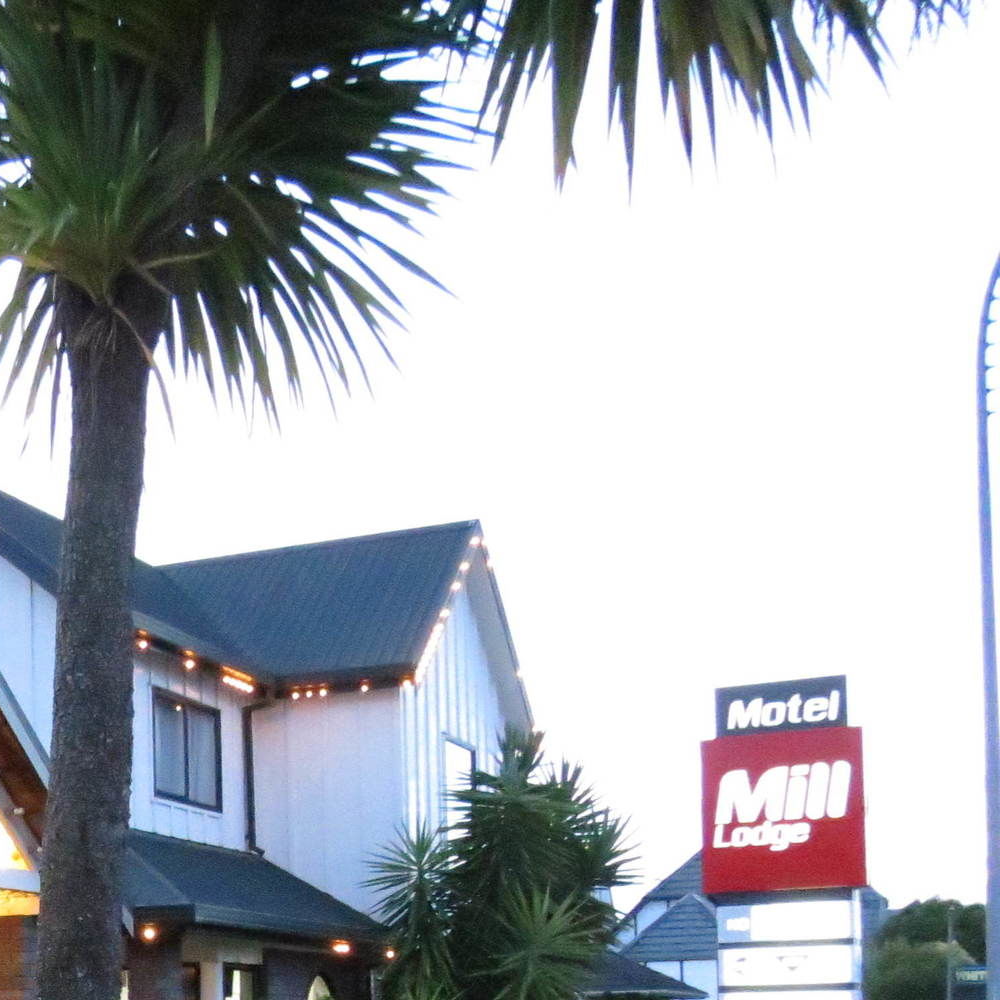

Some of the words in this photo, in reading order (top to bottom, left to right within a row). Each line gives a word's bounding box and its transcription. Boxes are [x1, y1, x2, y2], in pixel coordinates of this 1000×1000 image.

[727, 690, 840, 730] Motel
[714, 760, 851, 824] Mill
[713, 820, 811, 851] Lodge
